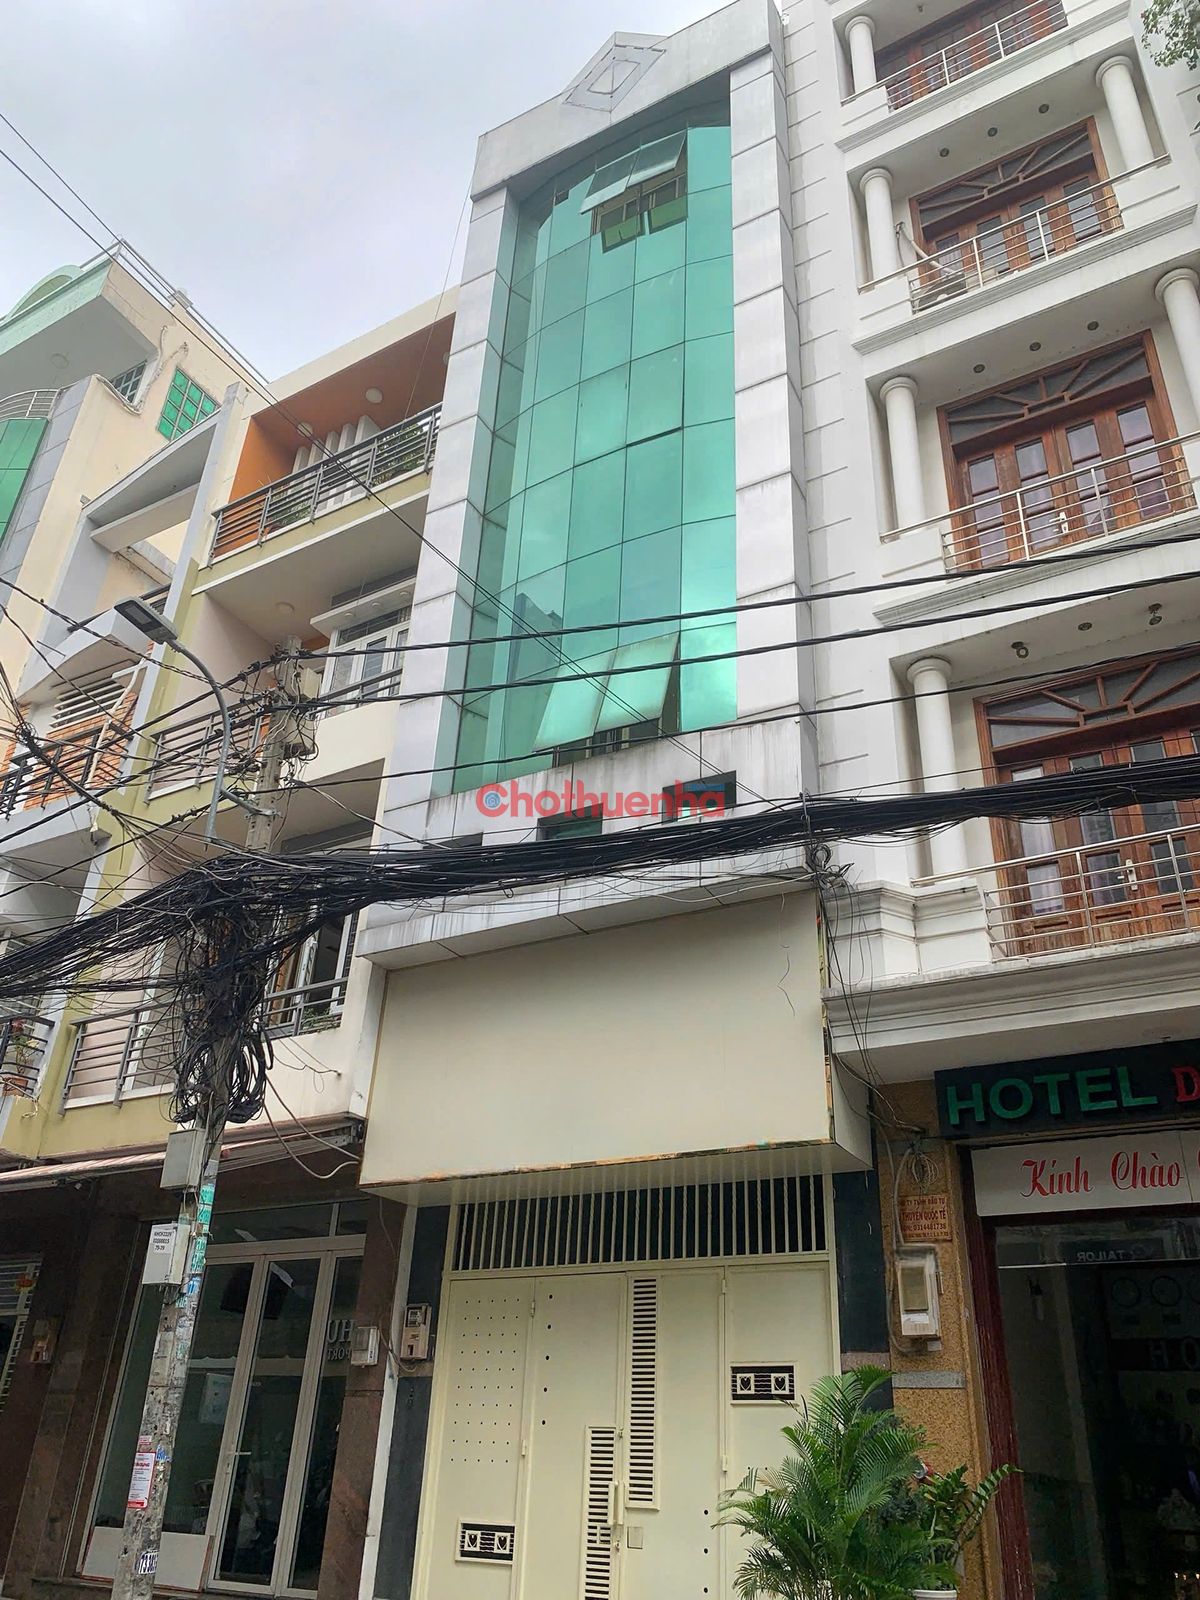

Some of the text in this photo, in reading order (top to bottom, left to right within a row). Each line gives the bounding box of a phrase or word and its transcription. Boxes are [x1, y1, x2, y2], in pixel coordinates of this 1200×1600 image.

[947, 1066, 1158, 1125] HOTEL
[1020, 1155, 1094, 1197] Kính
[1111, 1151, 1184, 1190] Chào
